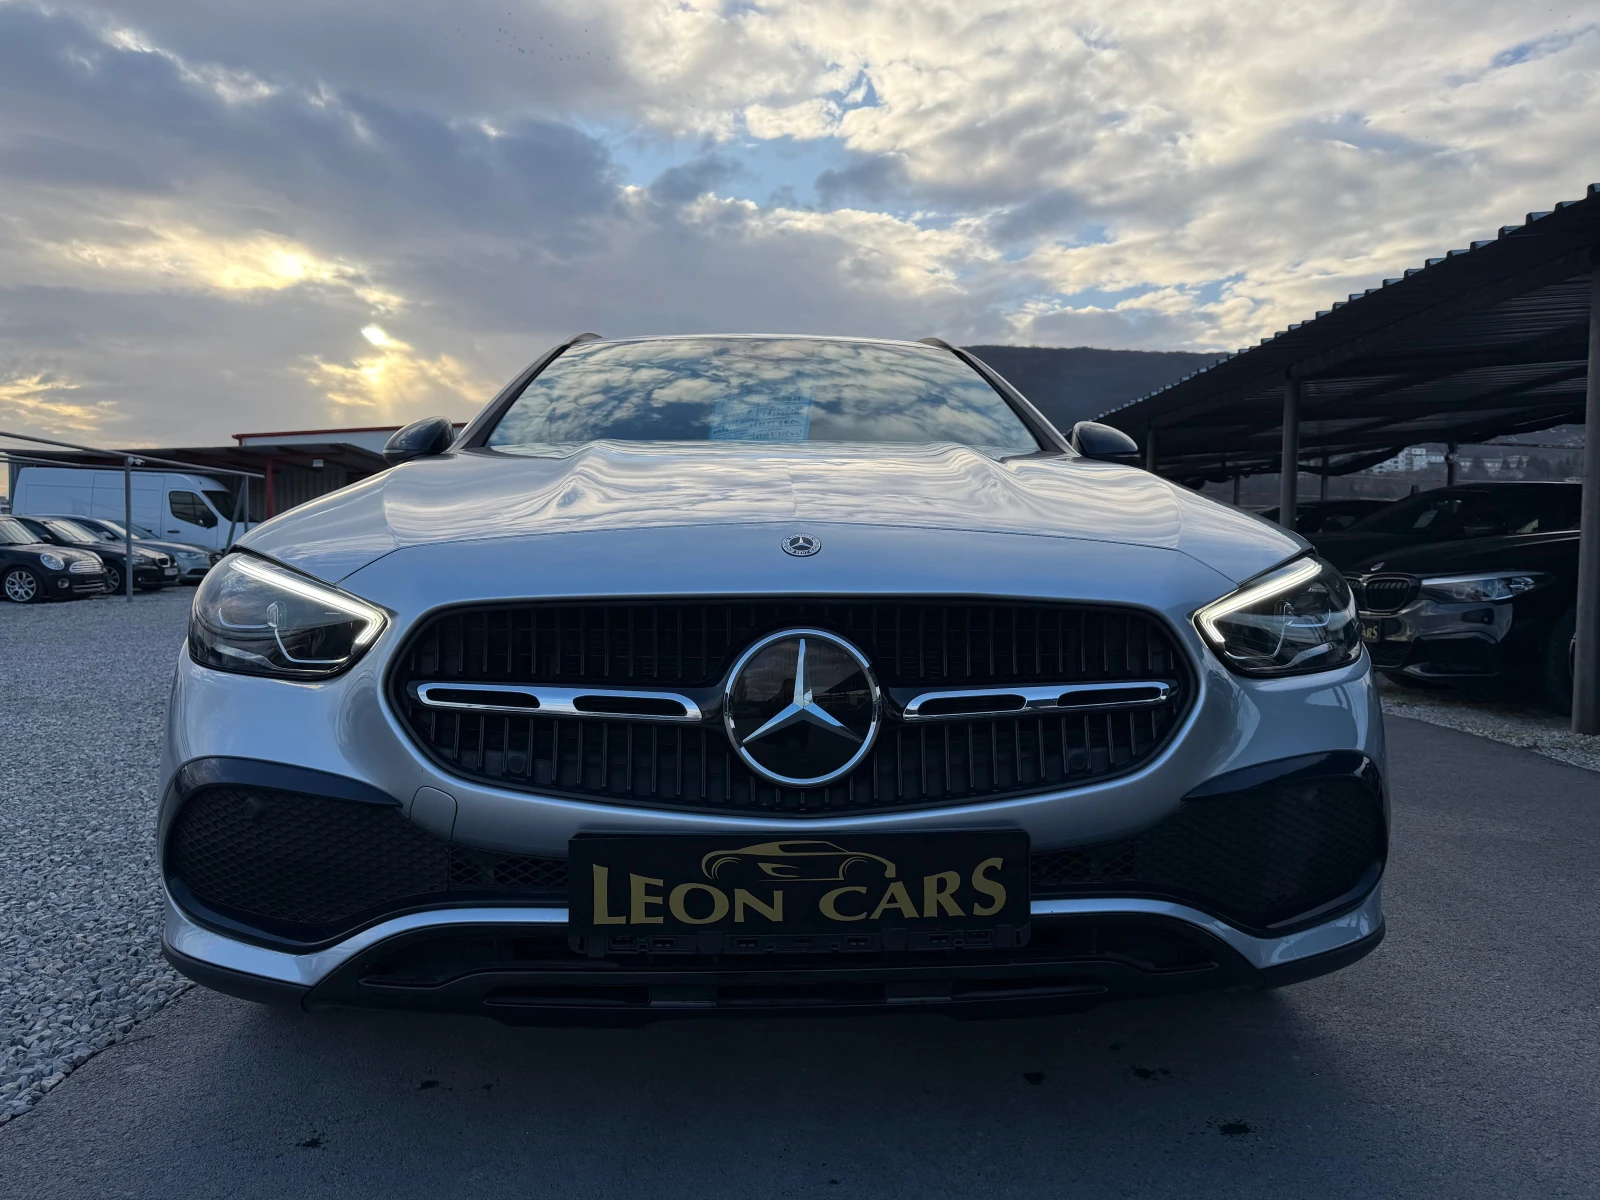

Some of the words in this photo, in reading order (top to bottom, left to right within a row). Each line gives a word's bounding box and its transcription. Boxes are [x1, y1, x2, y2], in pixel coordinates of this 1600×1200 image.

[1361, 625, 1378, 639] ARS
[592, 863, 783, 925] LEON
[818, 856, 1007, 922] CARS
